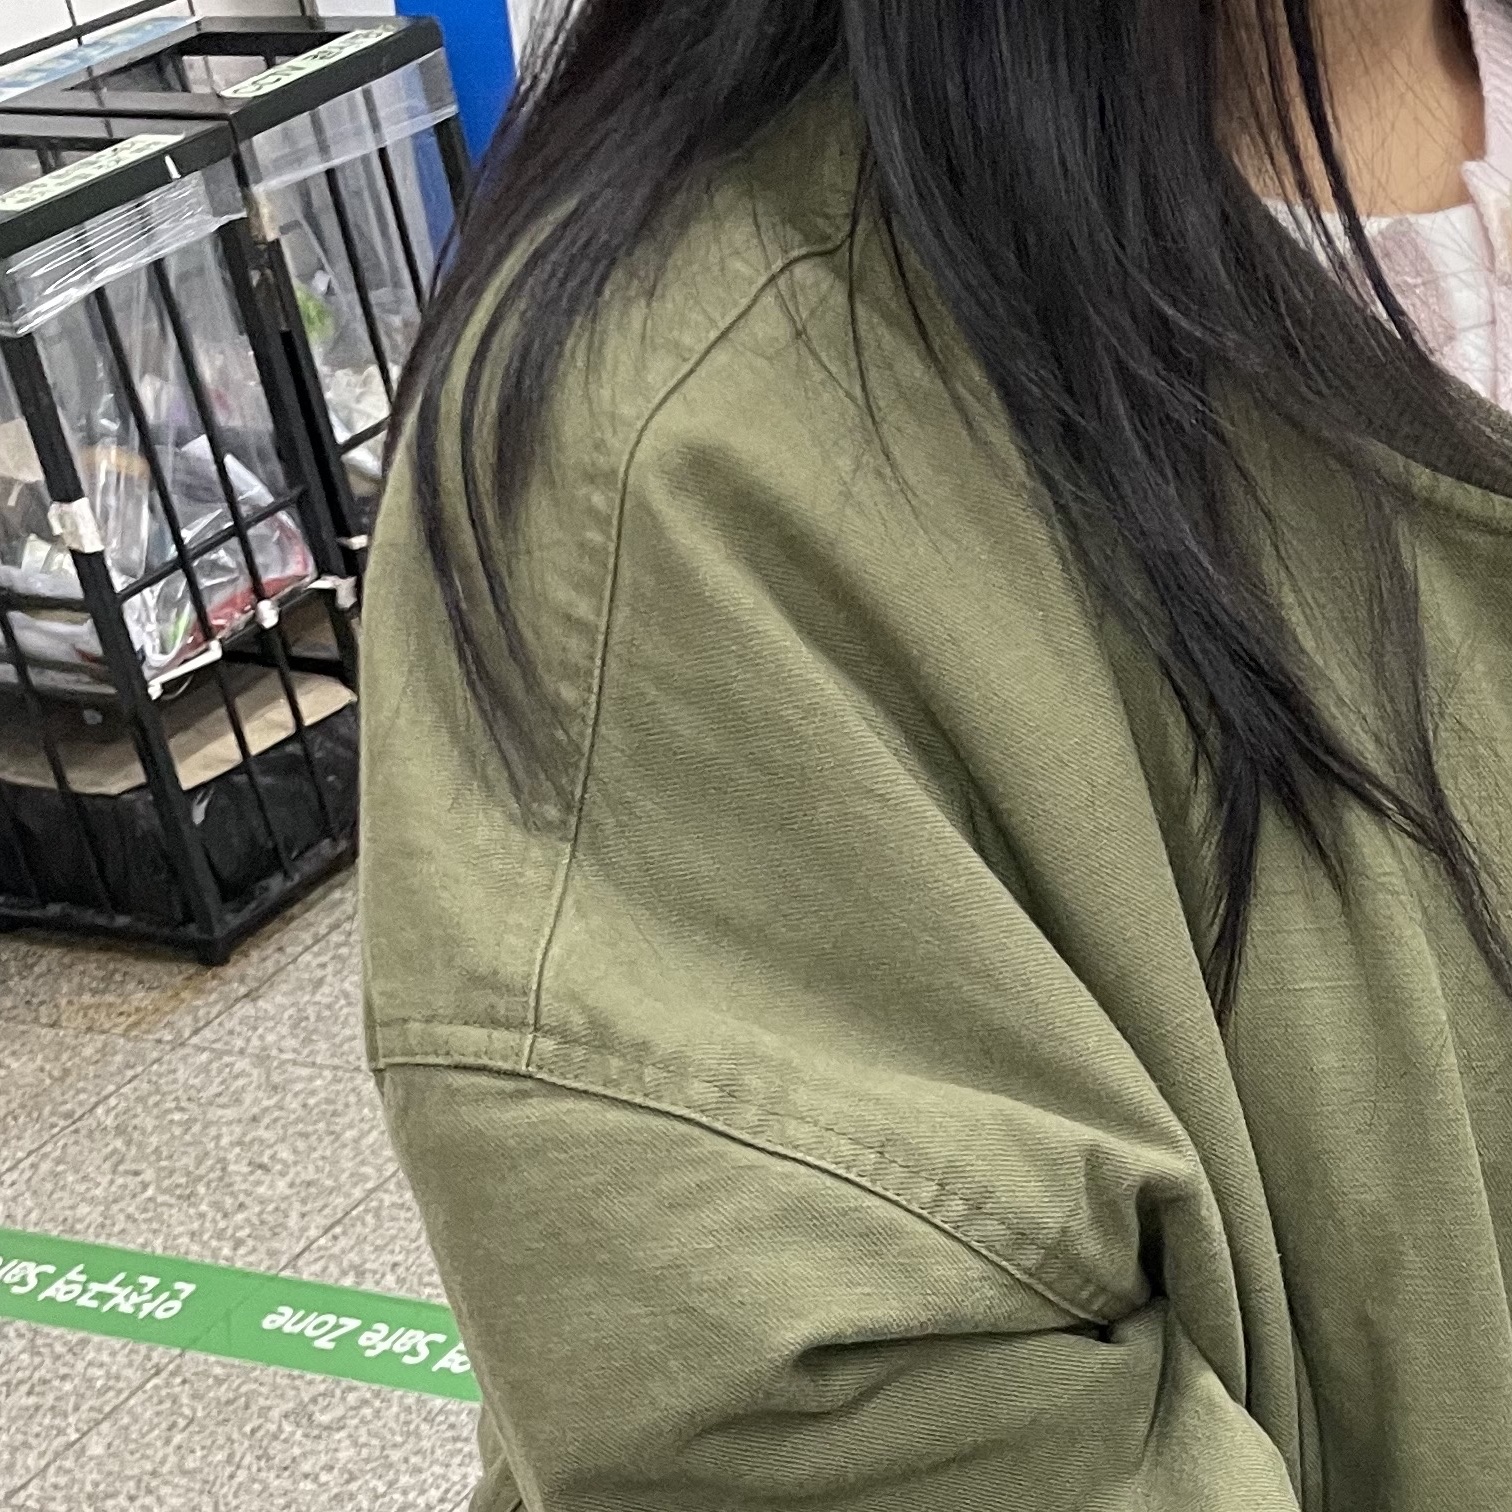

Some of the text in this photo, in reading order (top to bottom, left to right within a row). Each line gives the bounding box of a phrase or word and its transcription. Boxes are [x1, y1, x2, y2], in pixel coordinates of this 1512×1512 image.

[0, 1257, 196, 1320] 안전구역 Sa
[262, 1305, 362, 1350] Zone
[357, 1322, 447, 1365] Safe
